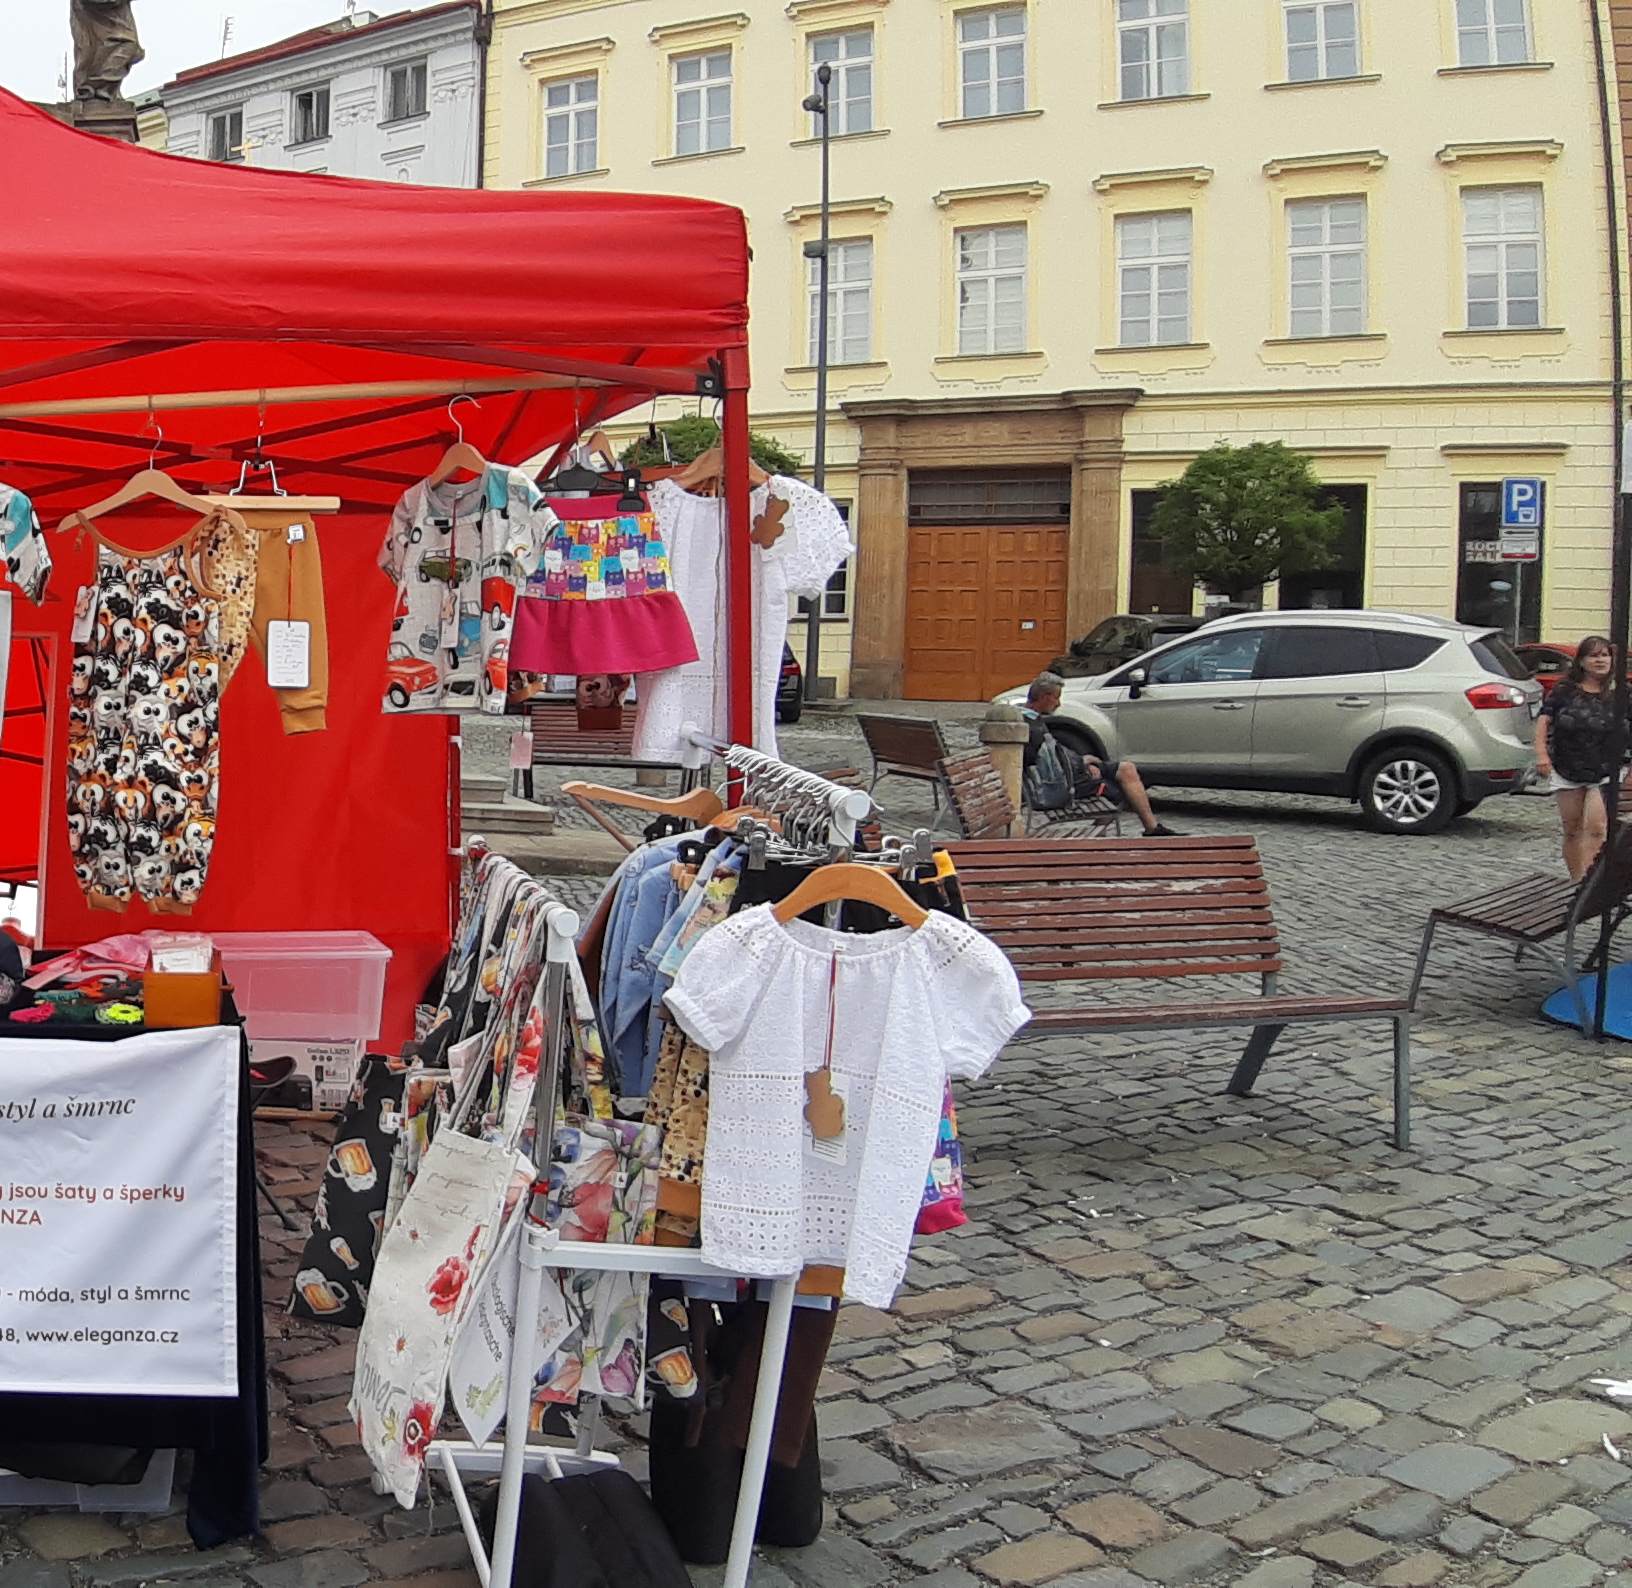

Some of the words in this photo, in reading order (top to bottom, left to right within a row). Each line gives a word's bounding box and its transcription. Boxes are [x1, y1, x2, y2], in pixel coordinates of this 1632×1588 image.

[1511, 483, 1534, 512] P
[43, 1103, 60, 1120] a
[64, 1090, 136, 1119] šmrnc
[8, 1182, 49, 1202] jsou
[55, 1182, 97, 1204] šaty
[102, 1187, 114, 1201] a
[120, 1183, 185, 1205] šperky
[19, 1285, 75, 1304] móda,
[80, 1284, 112, 1304] styl
[117, 1288, 129, 1301] a
[134, 1284, 191, 1302] šmrnc
[26, 1327, 179, 1346] www.eleganza.cz
